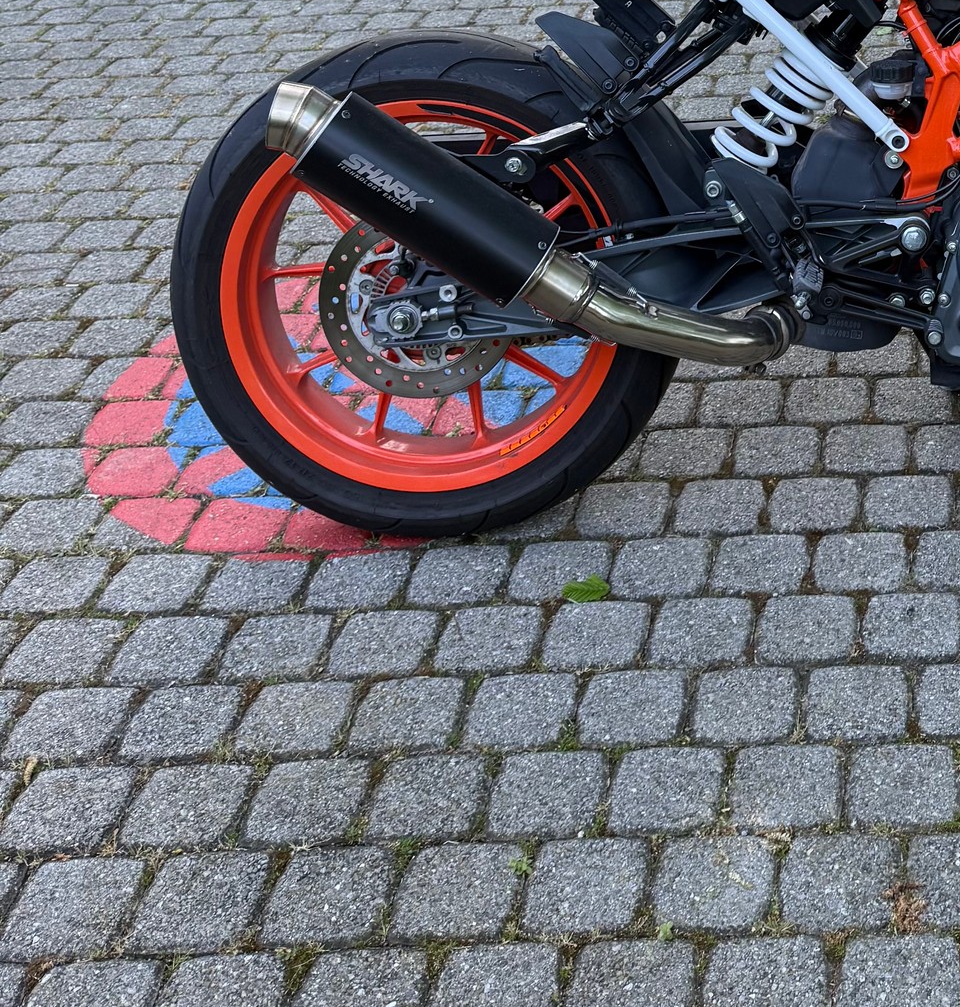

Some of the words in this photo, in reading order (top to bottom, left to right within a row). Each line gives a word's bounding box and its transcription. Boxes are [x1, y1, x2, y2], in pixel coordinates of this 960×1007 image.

[336, 162, 383, 193] TECHNOLOGY
[382, 192, 416, 214] EXHAUST
[340, 153, 429, 211] SHARK
